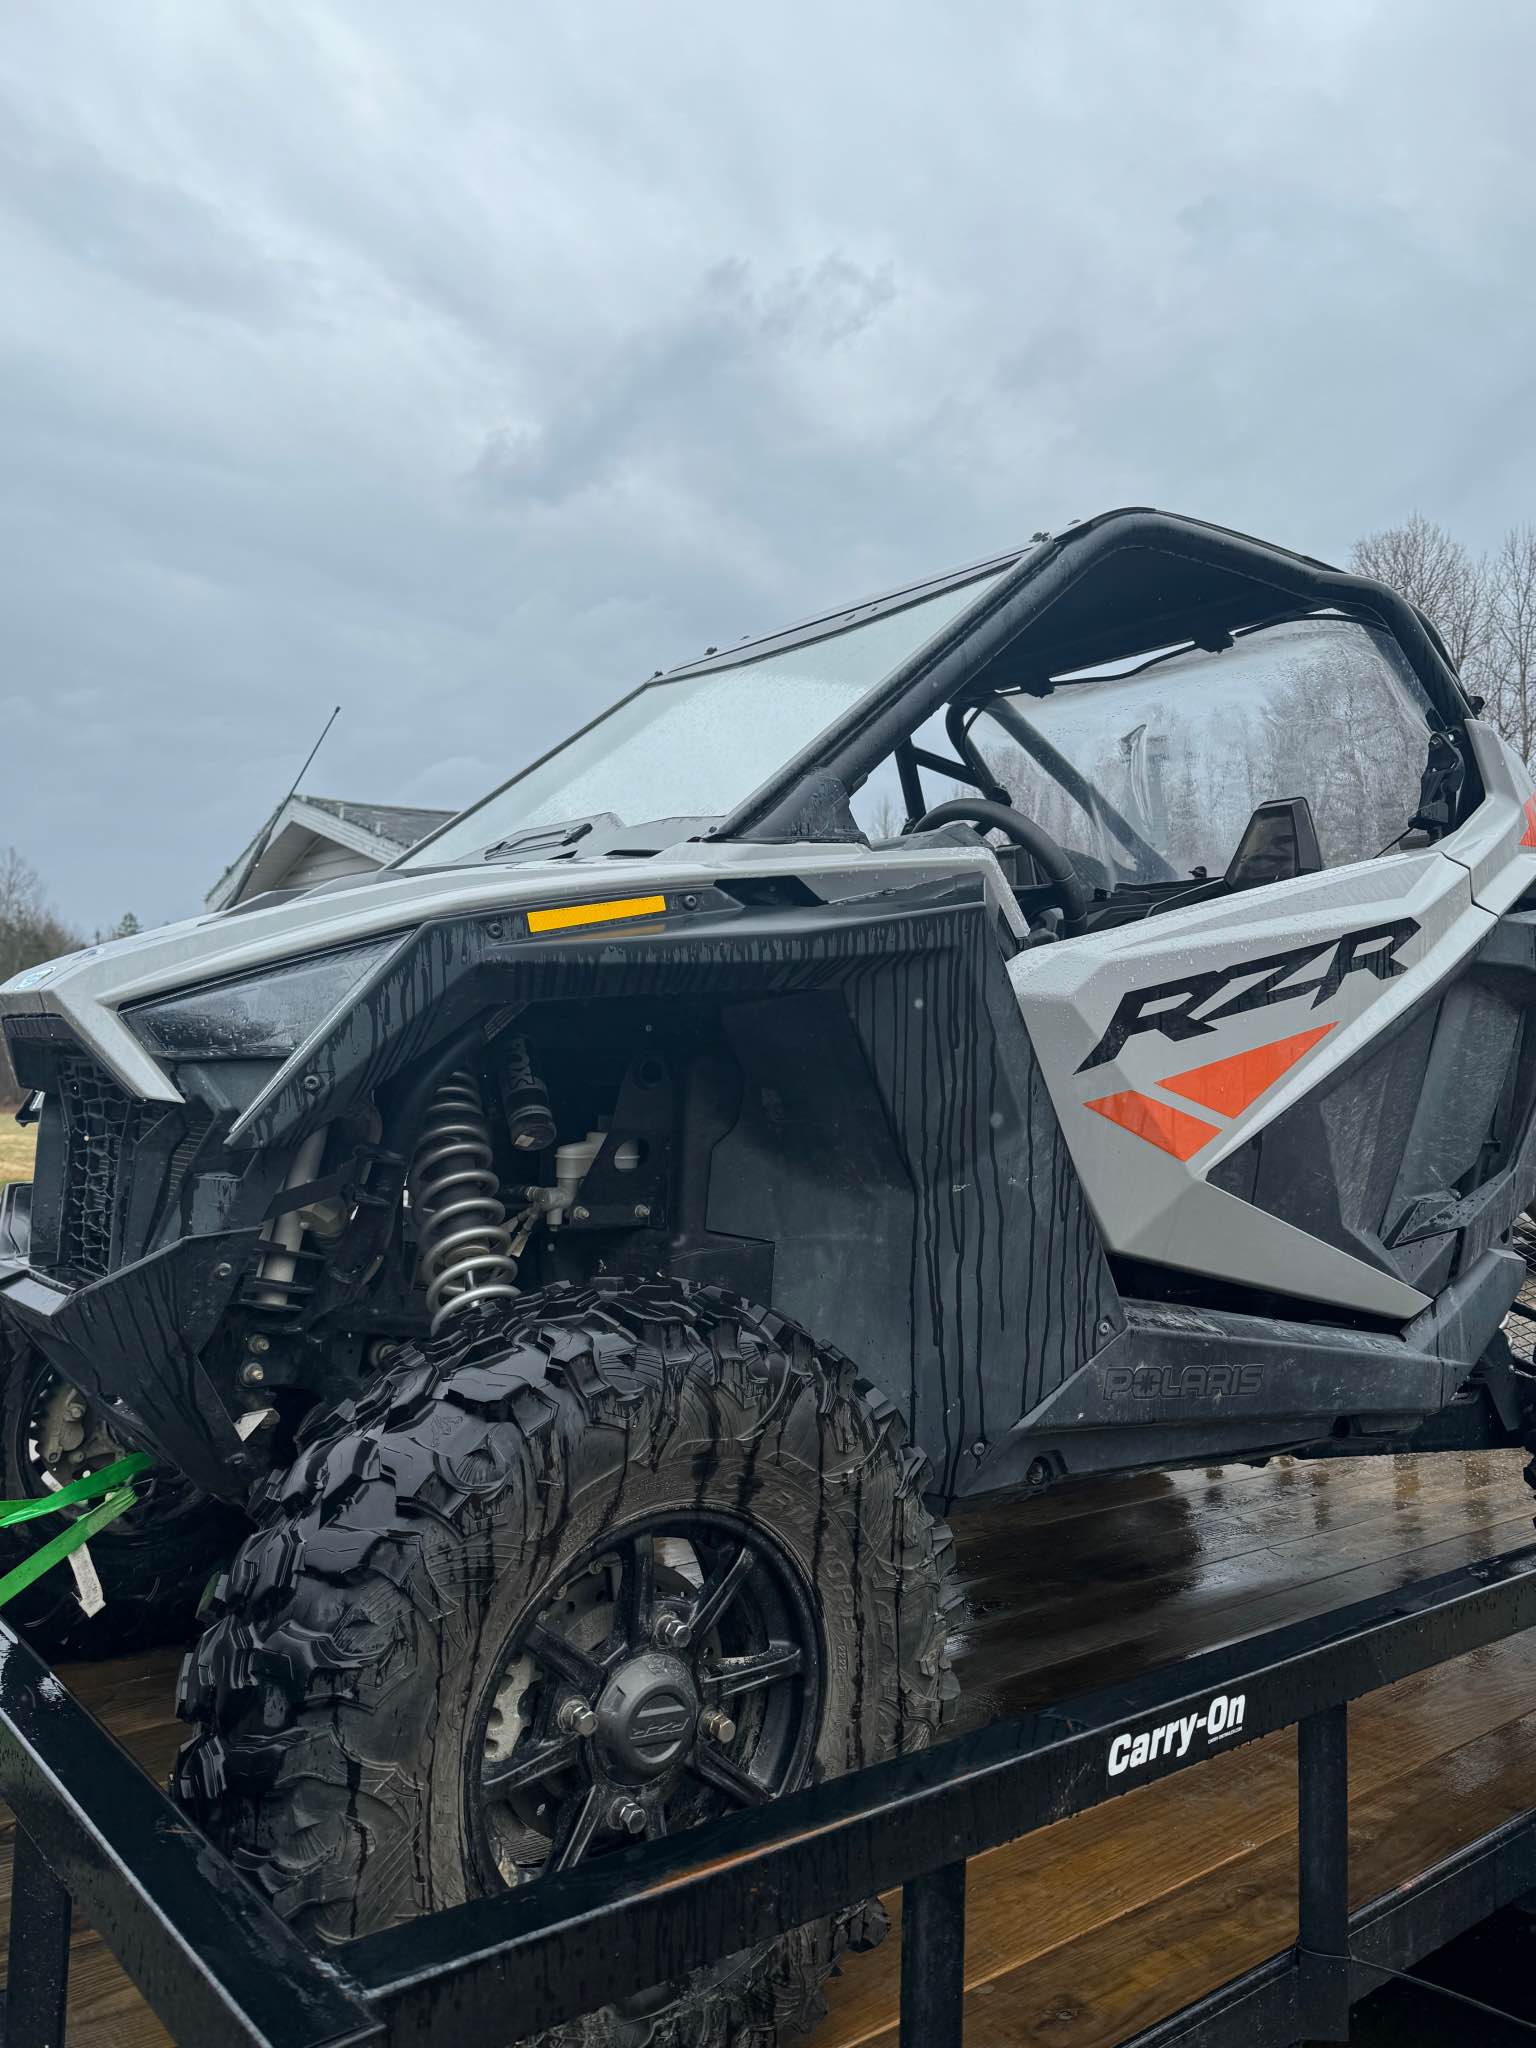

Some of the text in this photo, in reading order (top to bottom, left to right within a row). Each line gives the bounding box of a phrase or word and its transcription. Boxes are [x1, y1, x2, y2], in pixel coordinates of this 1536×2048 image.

[1072, 917, 1421, 1075] RZR
[1103, 1364, 1264, 1400] POLARIS
[1108, 1694, 1246, 1776] Carry-On
